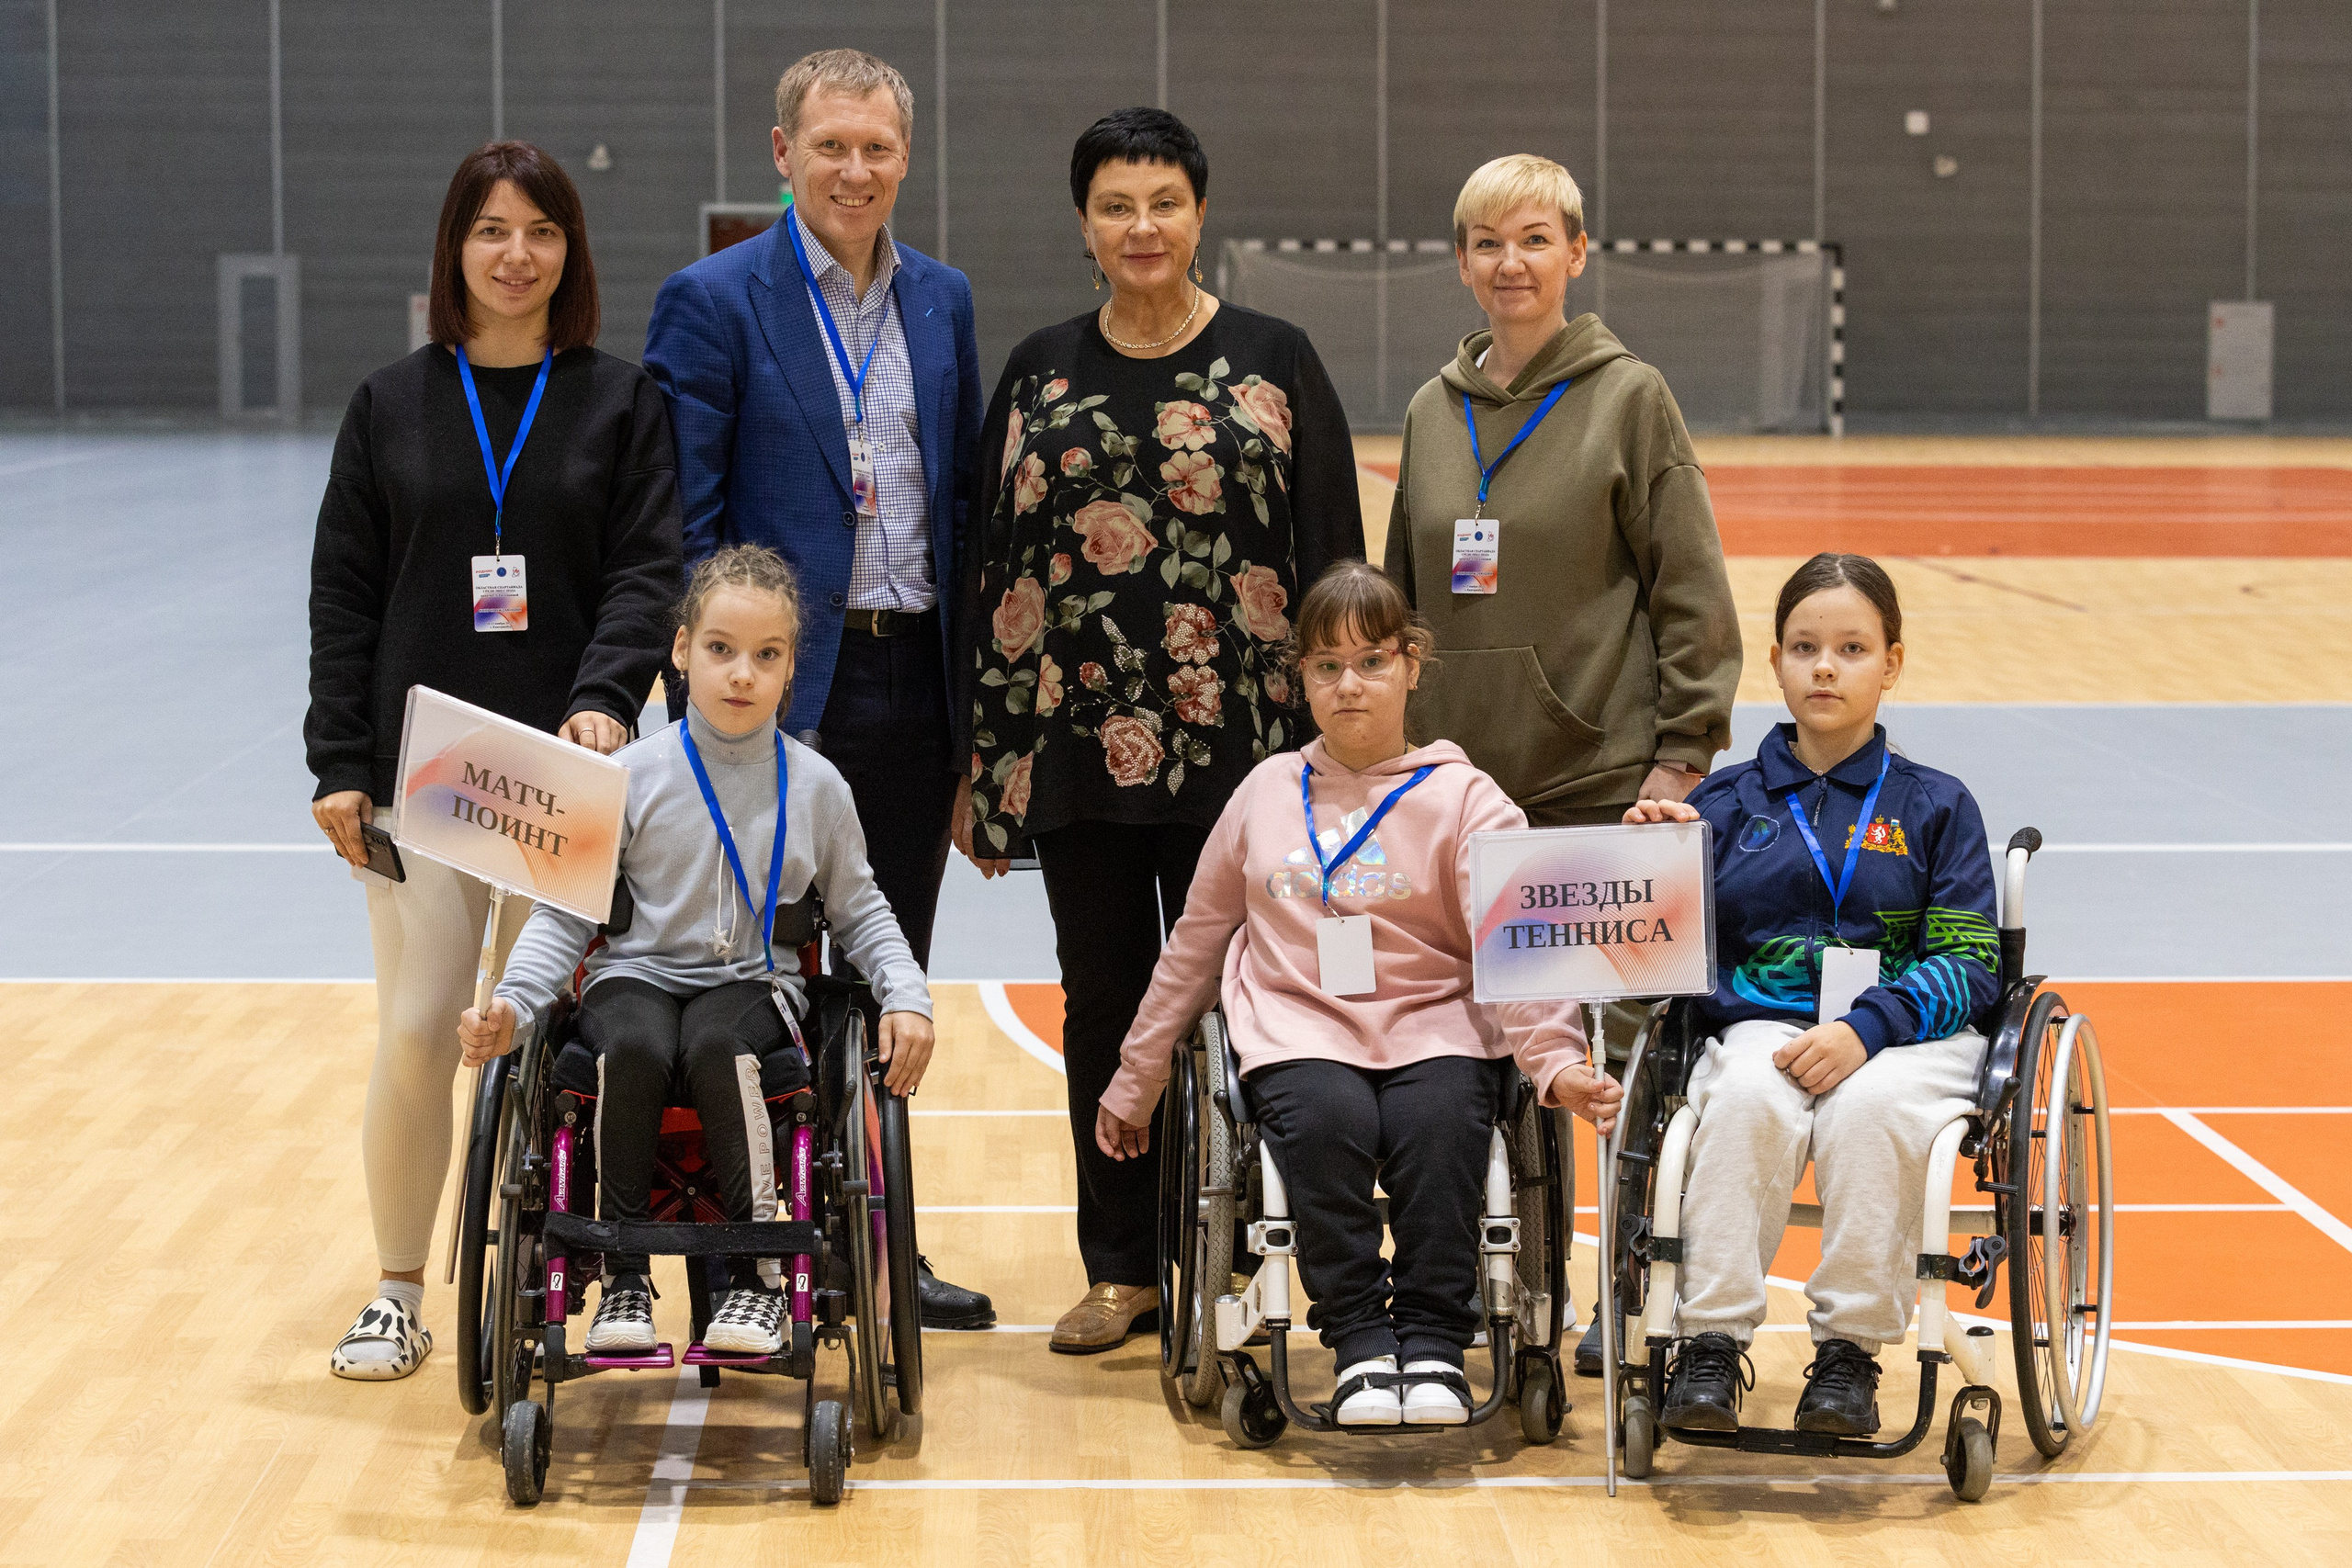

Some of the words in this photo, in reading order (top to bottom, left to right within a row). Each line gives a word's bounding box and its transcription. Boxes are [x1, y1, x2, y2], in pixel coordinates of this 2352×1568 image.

[462, 761, 566, 817] МАТЧ-
[451, 795, 569, 857] ПОИНТ
[1265, 864, 1412, 900] addas
[1520, 879, 1655, 912] ЗВЕЗДЫ
[1503, 918, 1674, 950] ТЕННИСА
